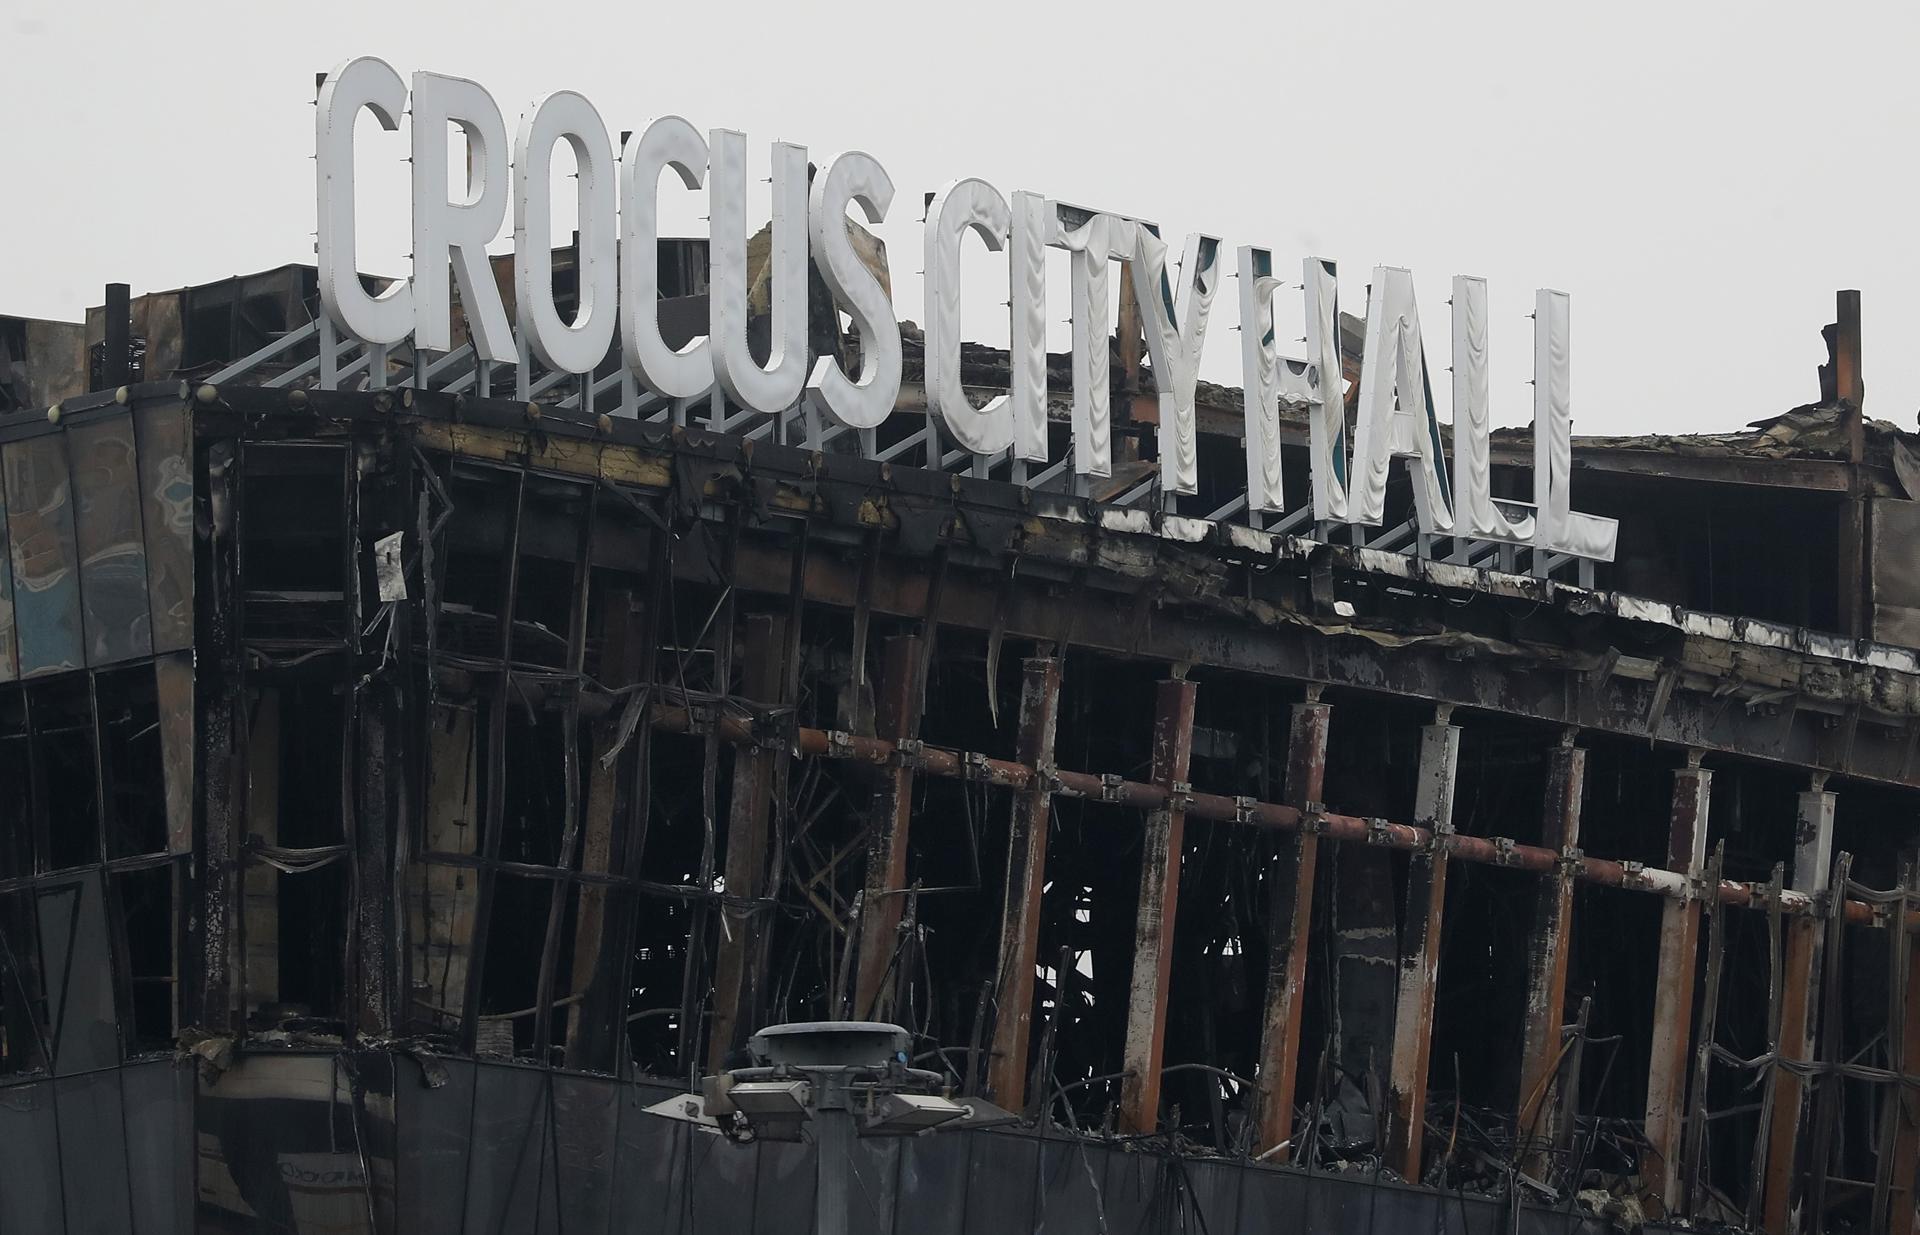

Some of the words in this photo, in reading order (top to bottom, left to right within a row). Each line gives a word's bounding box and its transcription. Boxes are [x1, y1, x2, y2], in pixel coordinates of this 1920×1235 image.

[316, 55, 903, 429] CROCUS
[924, 177, 1223, 495] CITY
[1238, 245, 1619, 562] HALL
